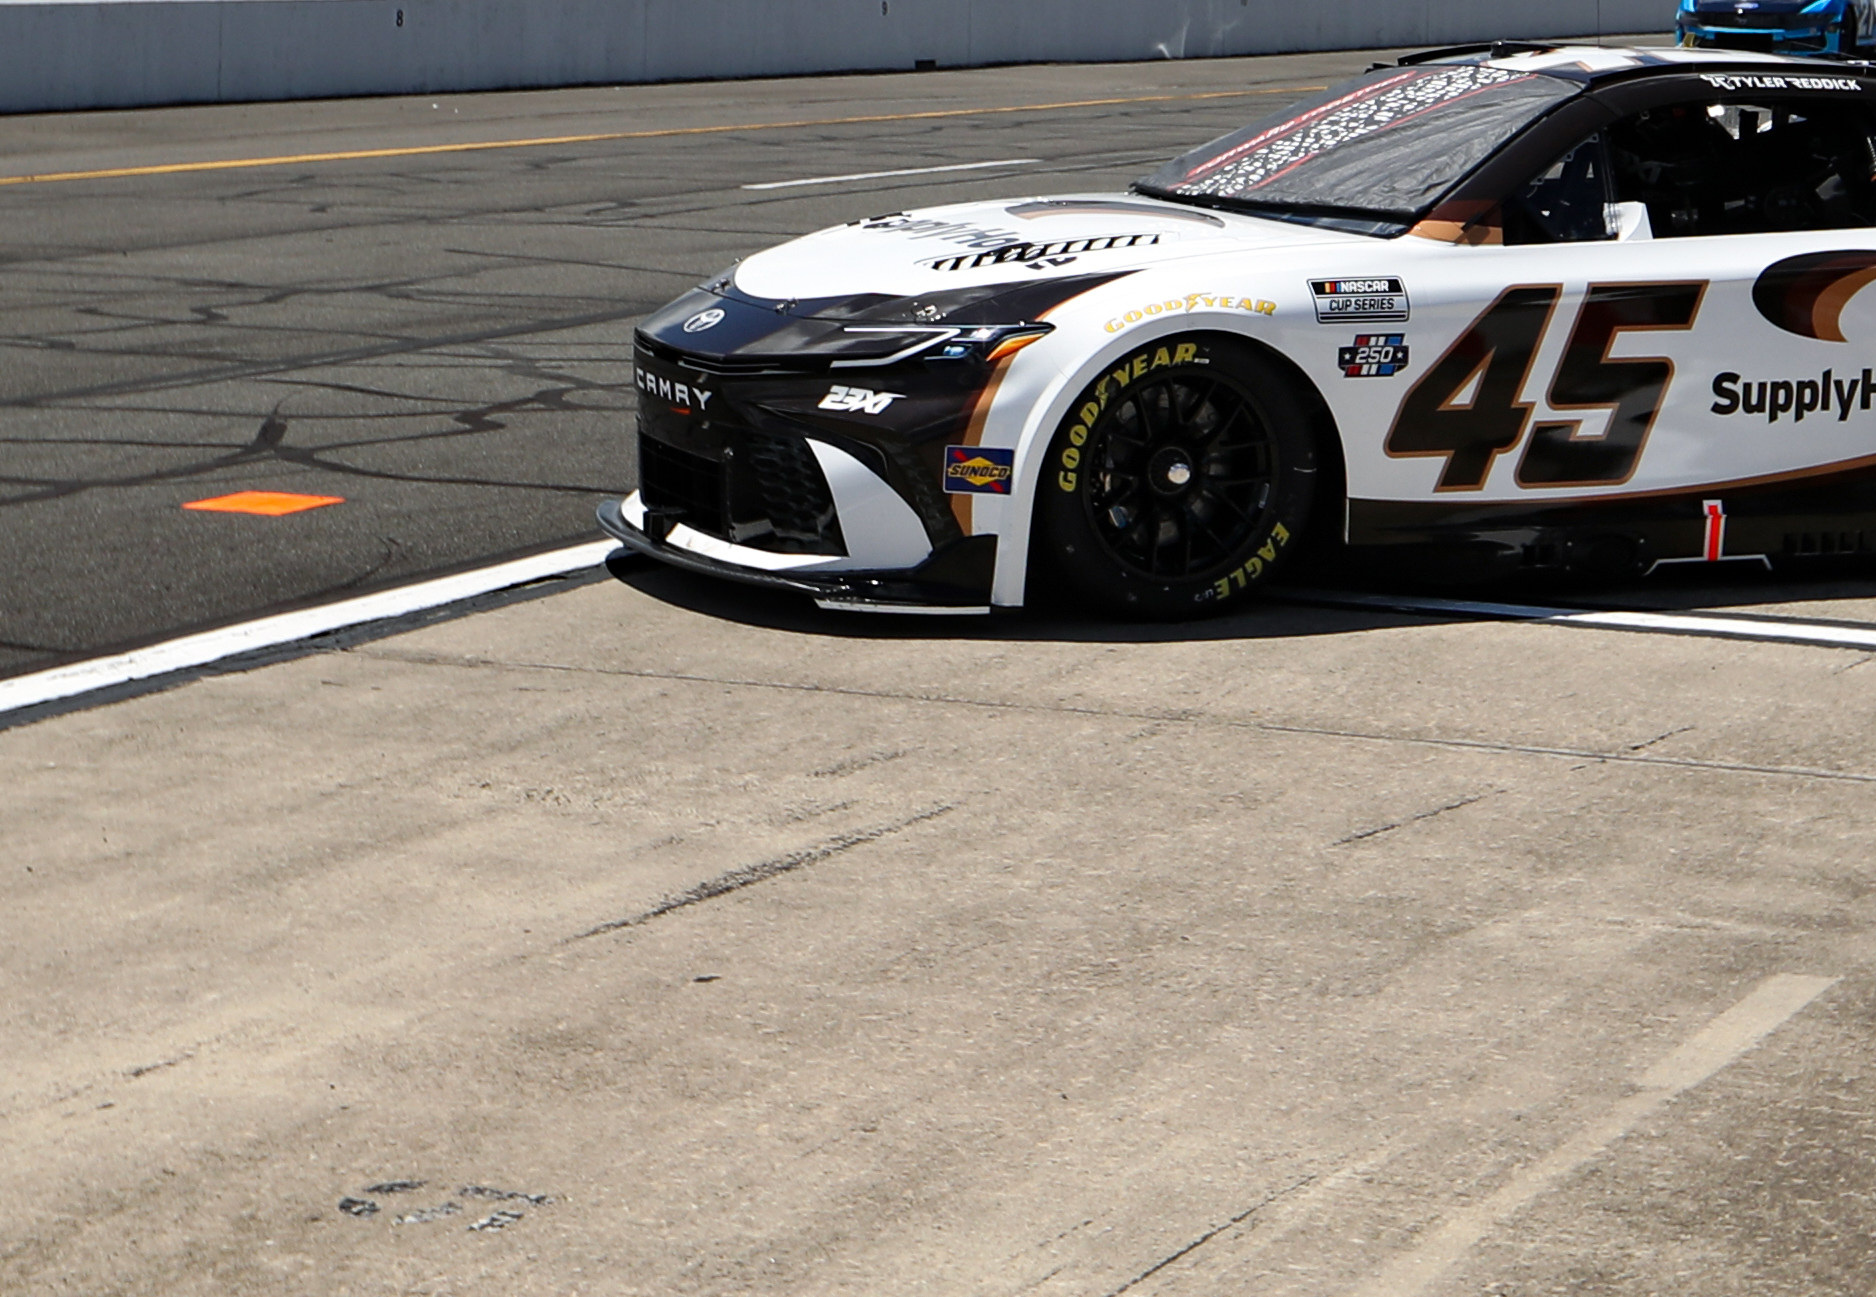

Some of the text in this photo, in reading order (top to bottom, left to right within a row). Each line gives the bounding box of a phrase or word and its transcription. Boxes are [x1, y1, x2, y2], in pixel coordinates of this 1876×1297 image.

[396, 9, 404, 27] 8
[1728, 76, 1788, 89] TYLER
[1785, 77, 1862, 91] REDDICK
[1341, 280, 1389, 293] NASCAR
[1104, 292, 1278, 333] GOODYEAR
[1329, 298, 1395, 312] CUP SERIES
[1355, 346, 1394, 364] 250
[635, 367, 713, 411] CAMRY
[1383, 279, 1710, 493] 45
[1058, 342, 1198, 493] GOODYEAR
[949, 463, 1011, 479] SUNOCO
[1214, 522, 1291, 601] EAGLE
